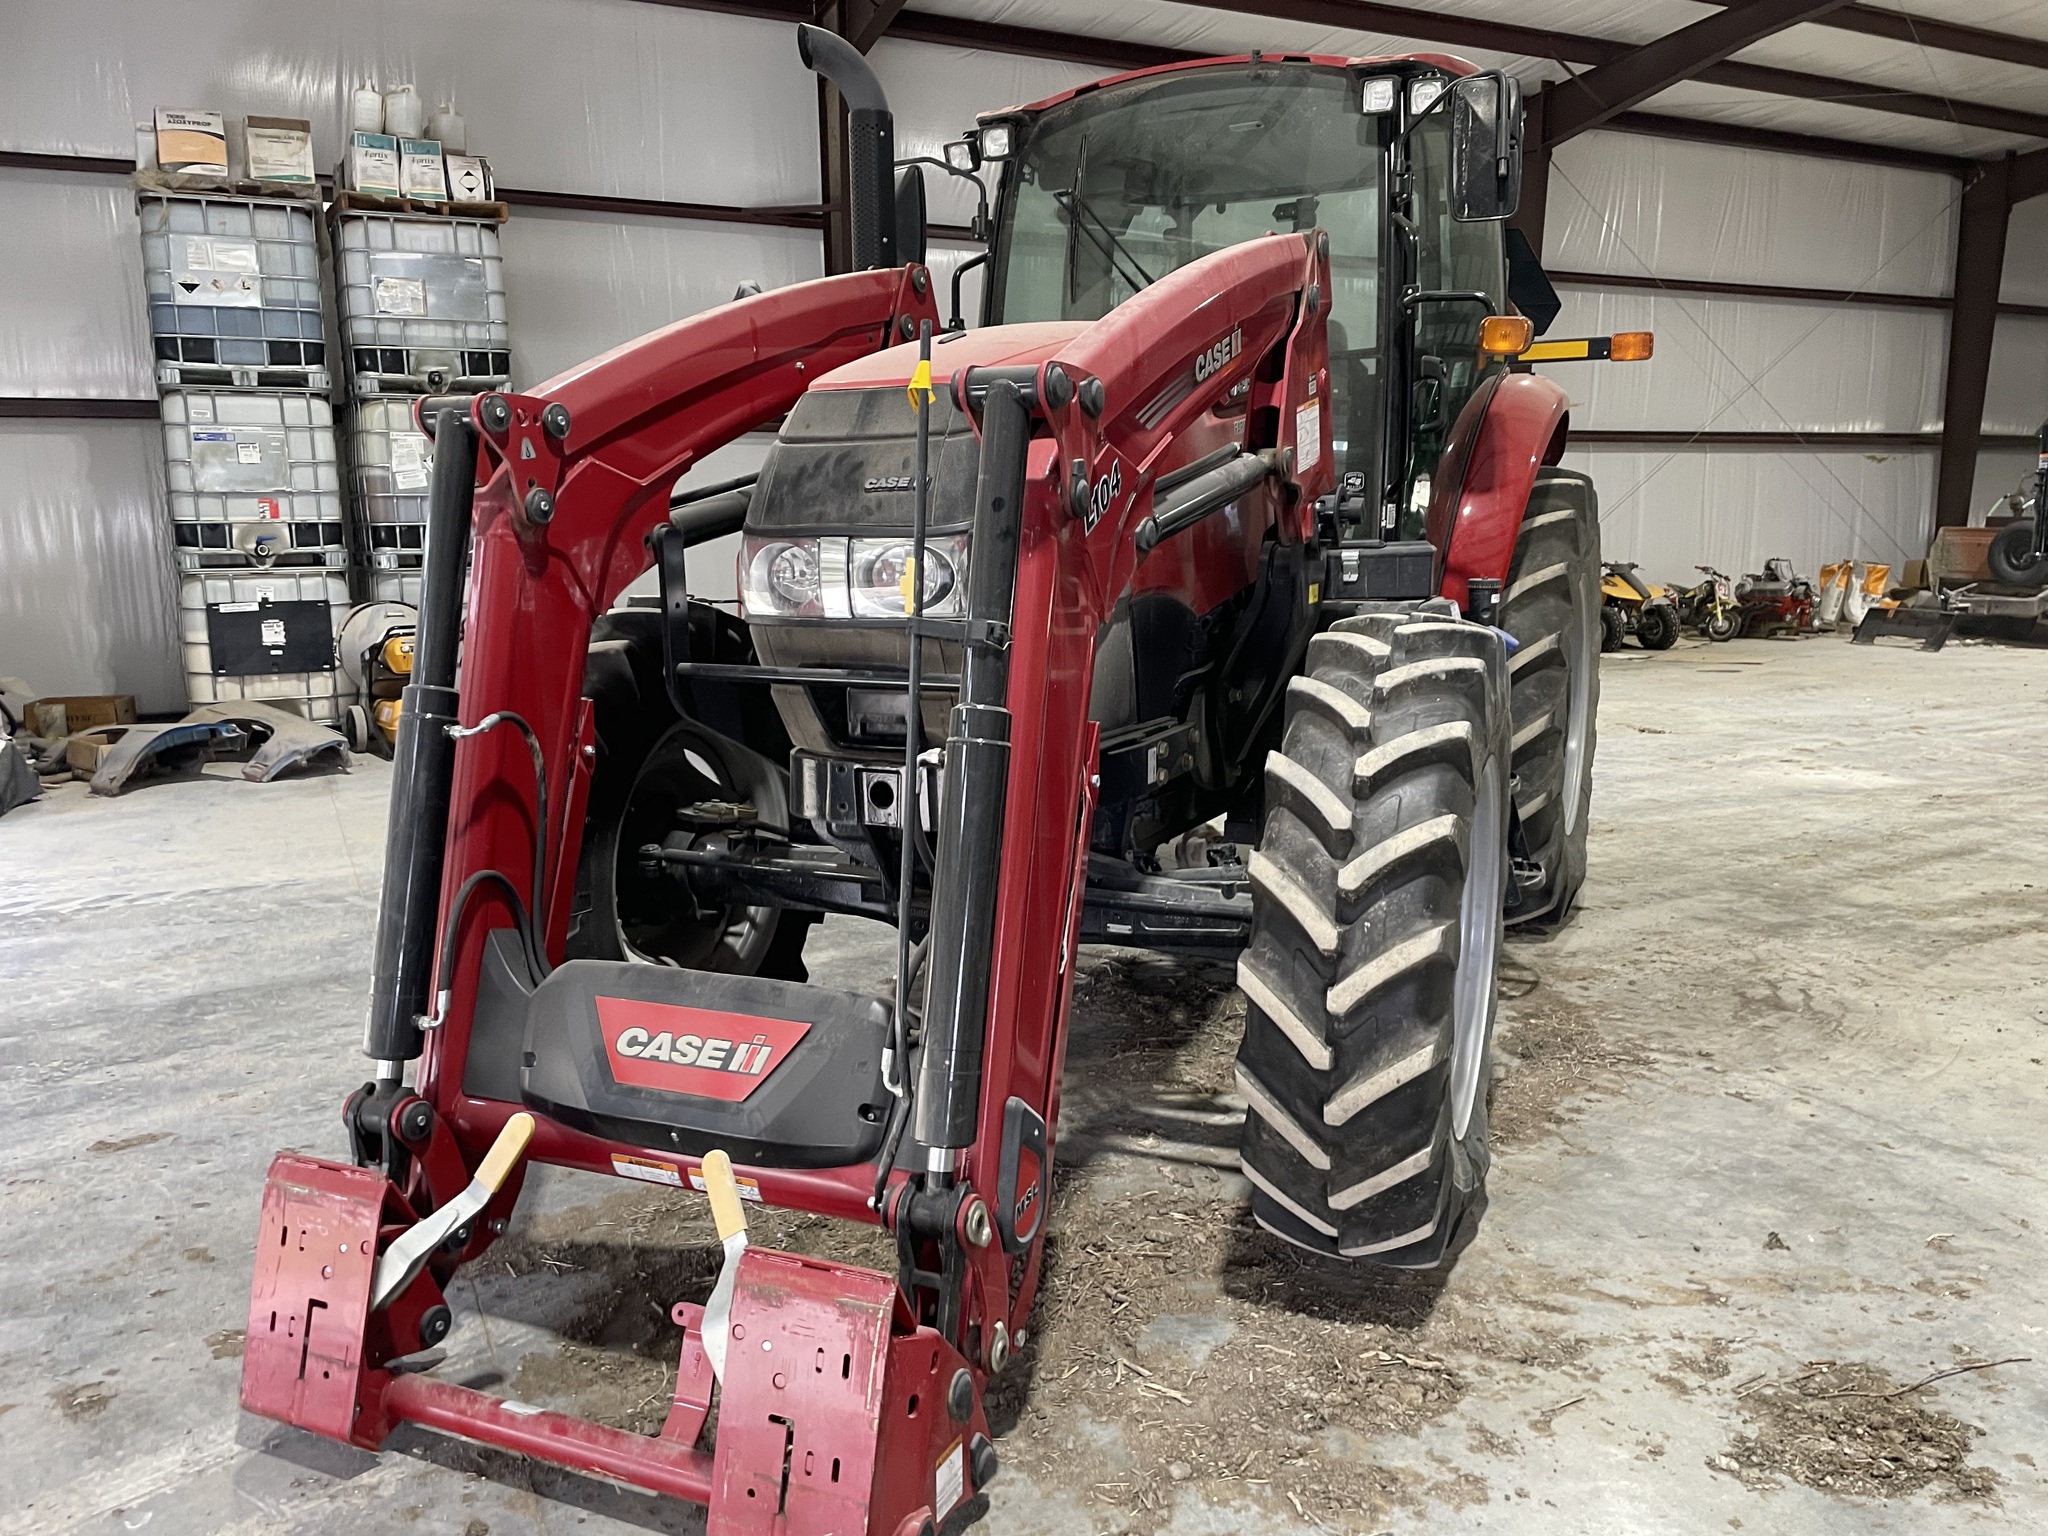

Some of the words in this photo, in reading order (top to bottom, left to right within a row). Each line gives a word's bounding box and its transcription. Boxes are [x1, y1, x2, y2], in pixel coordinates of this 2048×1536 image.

[1195, 336, 1231, 383] CASE
[864, 476, 911, 490] CASE
[1084, 457, 1122, 538] L104
[616, 1026, 733, 1070] CASE
[1015, 1181, 1040, 1225] MSL
